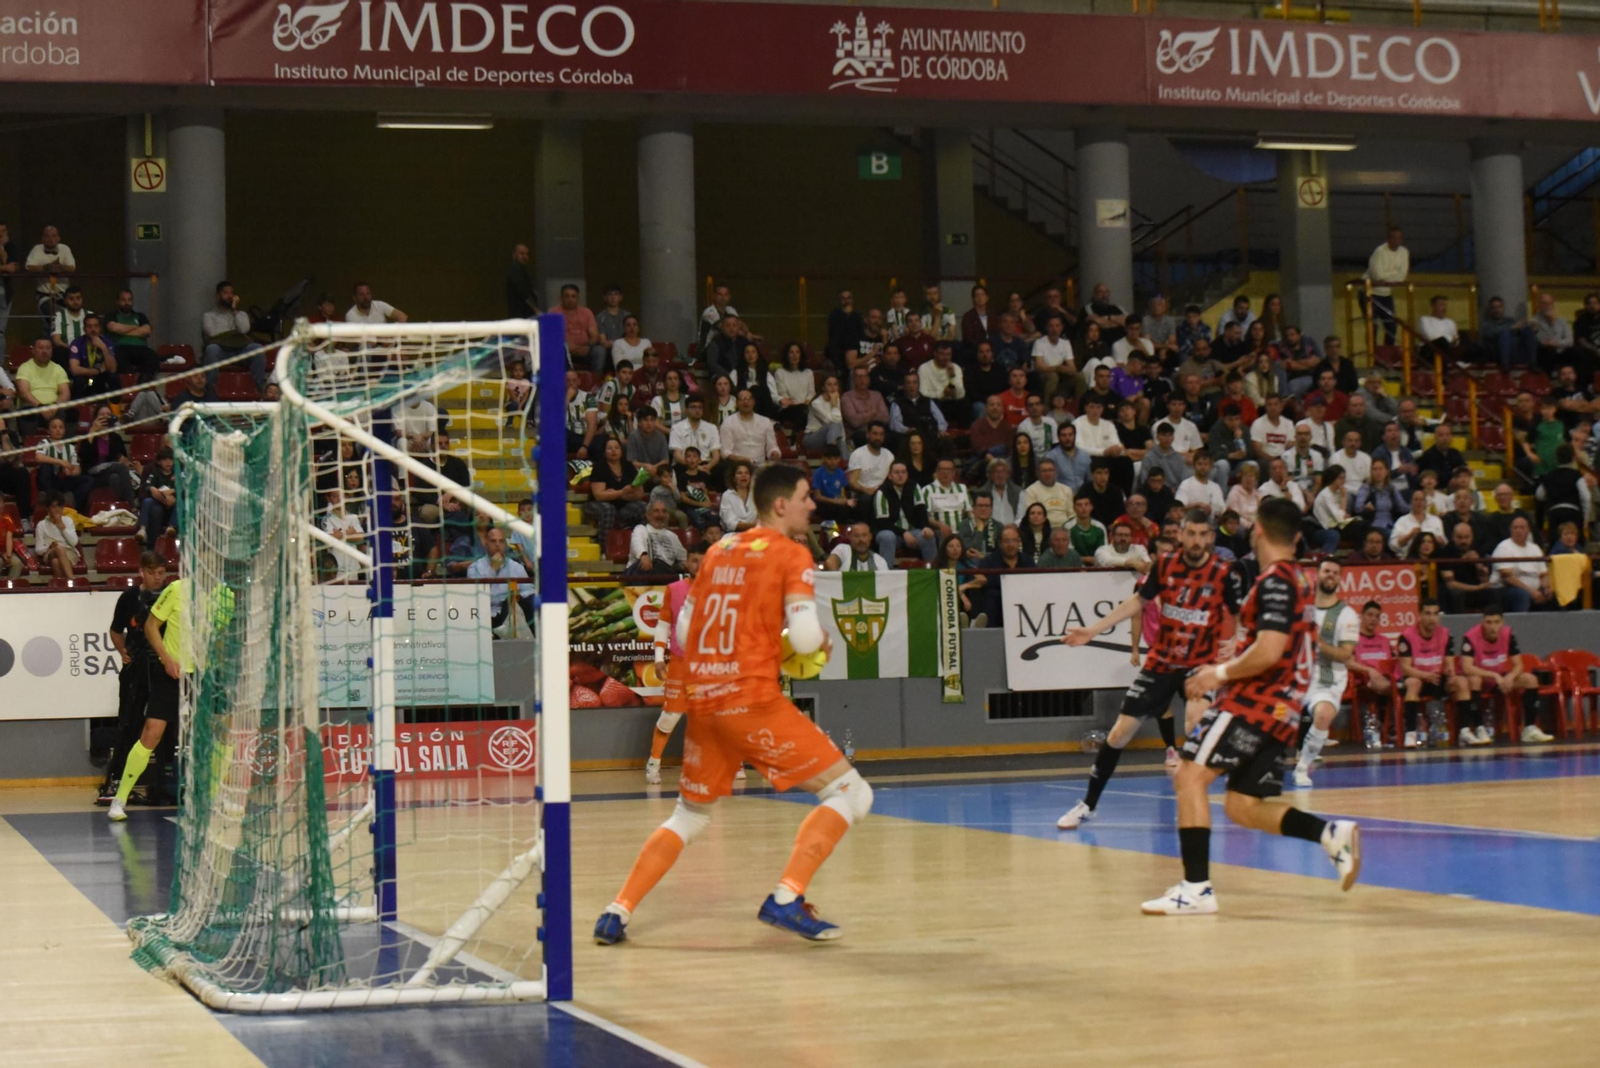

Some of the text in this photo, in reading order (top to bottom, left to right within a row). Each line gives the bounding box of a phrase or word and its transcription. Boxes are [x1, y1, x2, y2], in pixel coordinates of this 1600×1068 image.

[360, 1, 635, 57] IMDECO
[900, 28, 1026, 54] AYUNTAMIENTO
[901, 54, 1009, 81] DE CÓRDOBA
[1228, 28, 1461, 84] IMDECO
[275, 63, 634, 86] Instituto Municipal de Deportes Córdoba
[1158, 84, 1461, 110] Instituto Municipal de Deportes Córdoba
[871, 153, 889, 174] B
[698, 593, 740, 655] 25
[945, 579, 957, 670] CÓRDOBA FUTSAL
[1014, 600, 1132, 637] MAS
[70, 634, 80, 677] GRUPO
[597, 643, 605, 654] y
[419, 745, 469, 772] SALA
